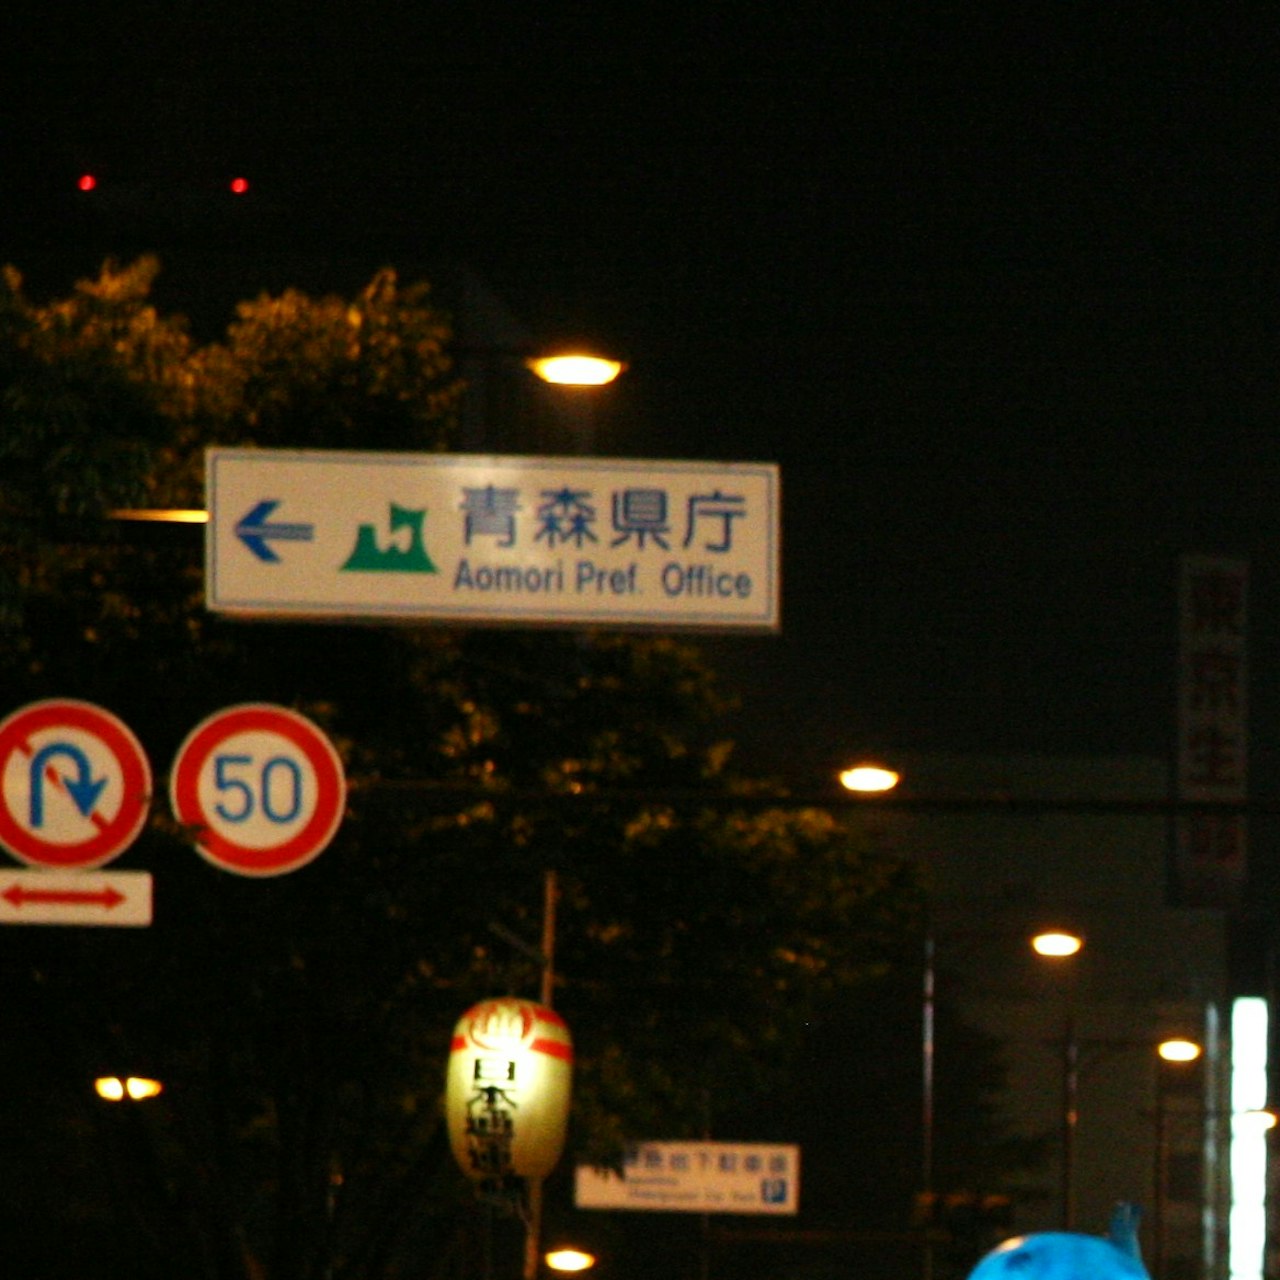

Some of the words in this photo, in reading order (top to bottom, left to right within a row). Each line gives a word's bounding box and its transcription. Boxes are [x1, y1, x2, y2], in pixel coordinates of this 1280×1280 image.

[459, 484, 747, 553] 青森県庁
[453, 558, 565, 591] Aomori
[662, 562, 752, 598] Office
[213, 754, 303, 824] 50
